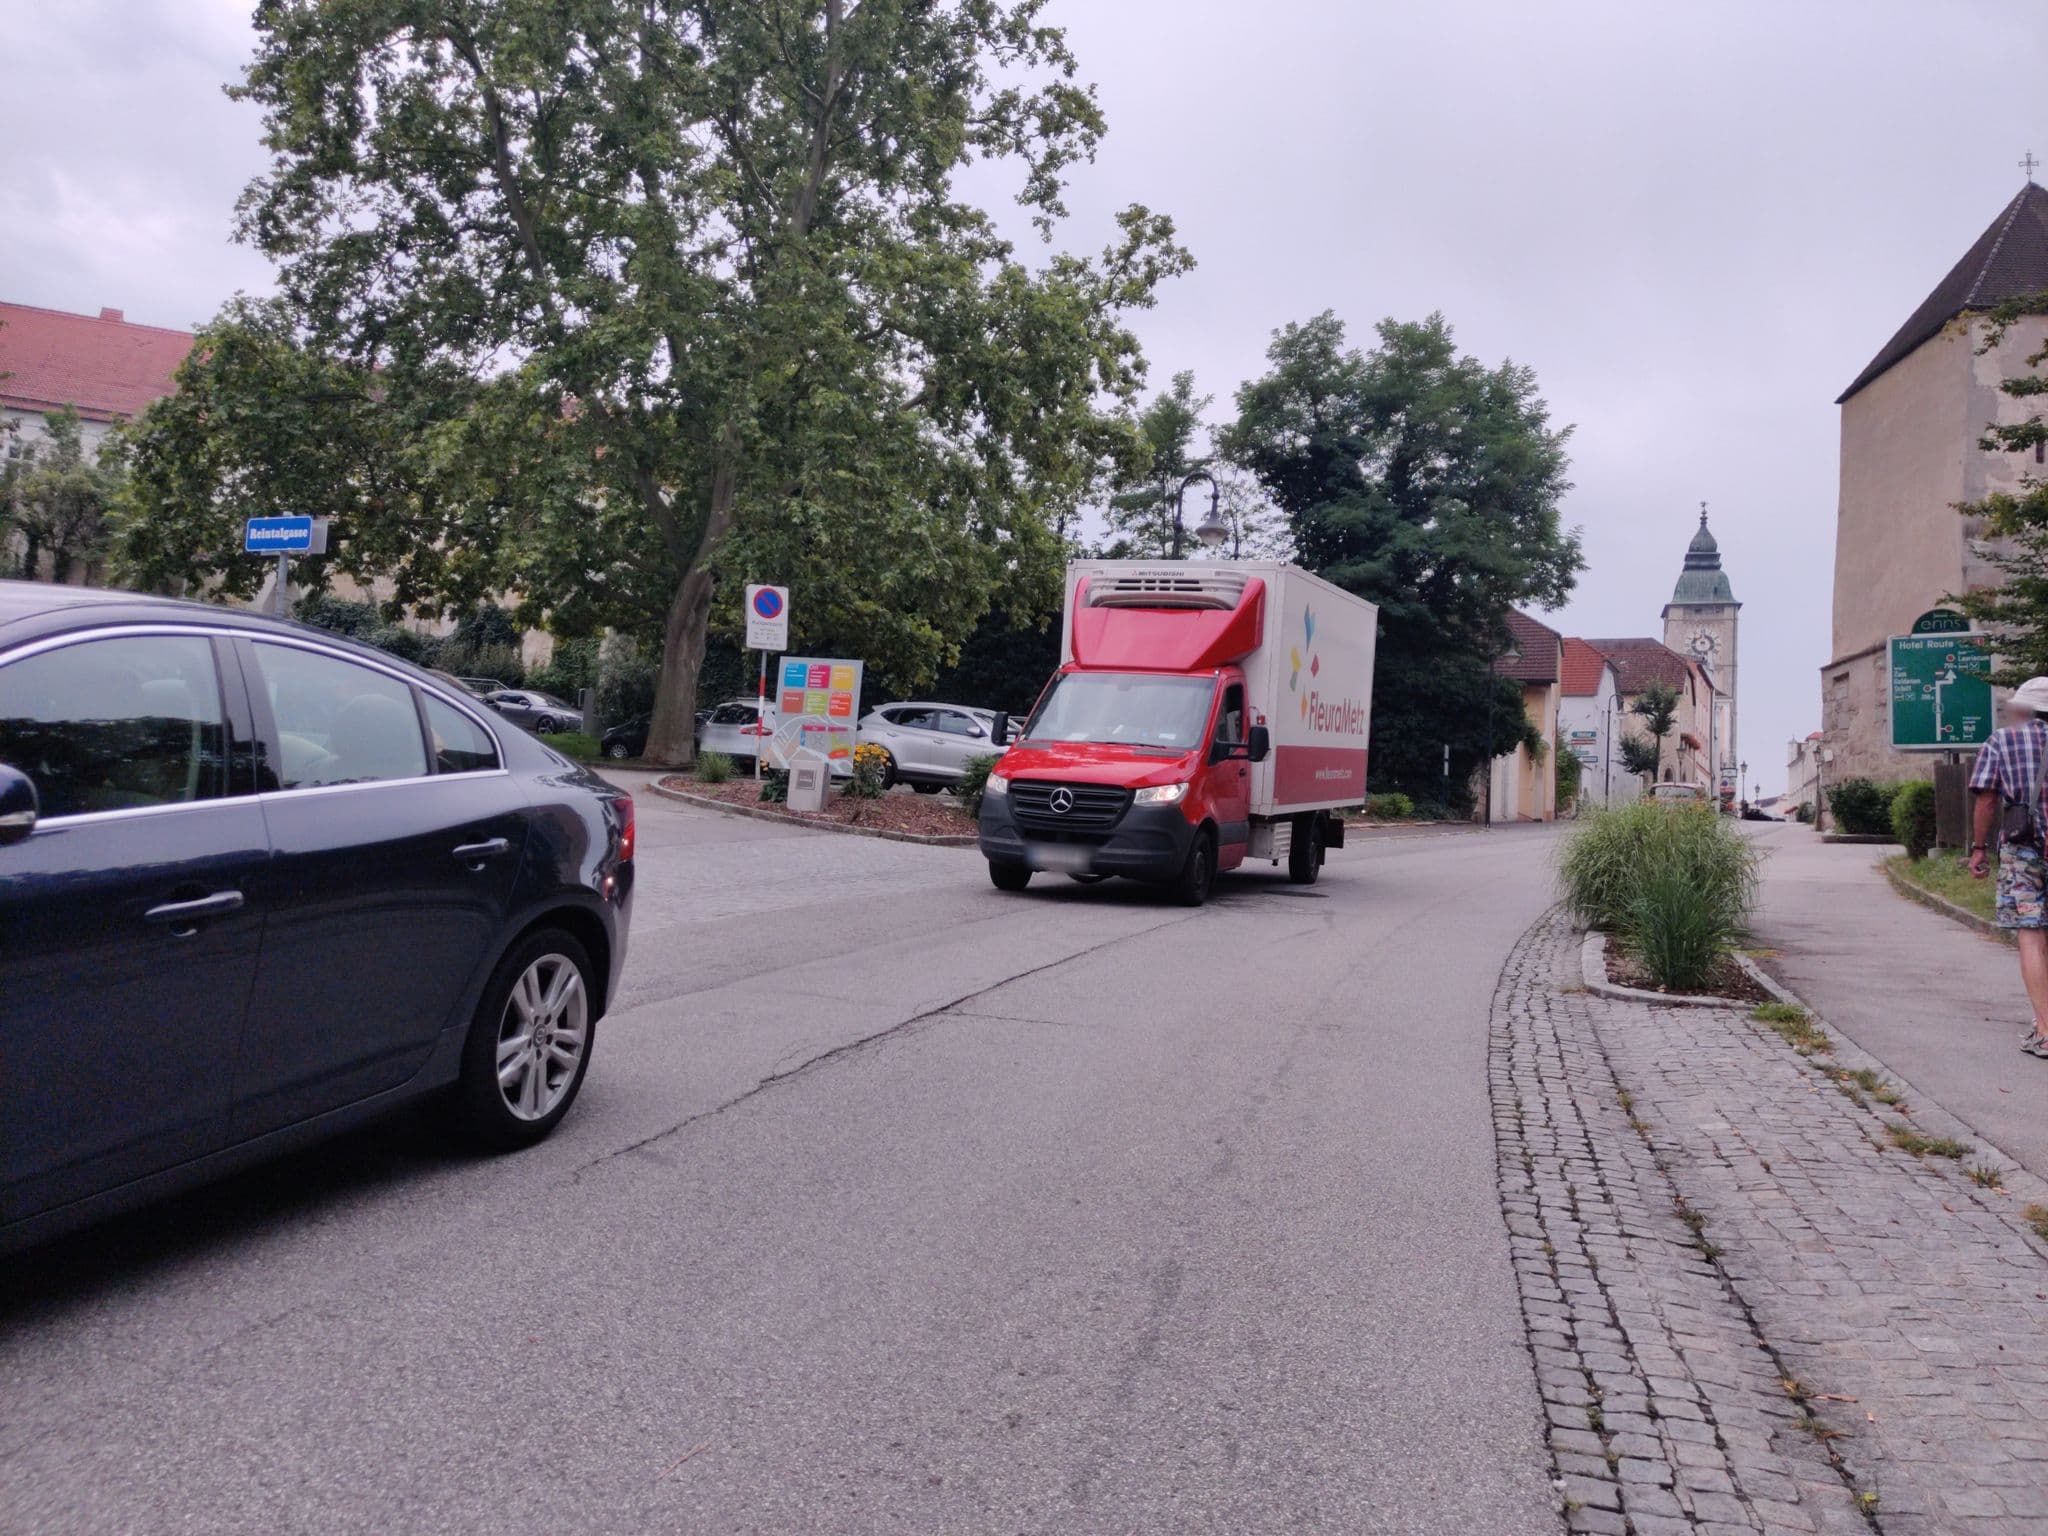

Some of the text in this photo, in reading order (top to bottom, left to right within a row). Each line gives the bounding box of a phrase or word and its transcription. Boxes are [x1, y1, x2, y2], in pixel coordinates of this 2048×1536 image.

[249, 527, 308, 541] Reintalgasse
[1920, 619, 1961, 631] enns
[1898, 640, 1954, 650] Hotel Route
[1308, 690, 1365, 736] FleuraMetz
